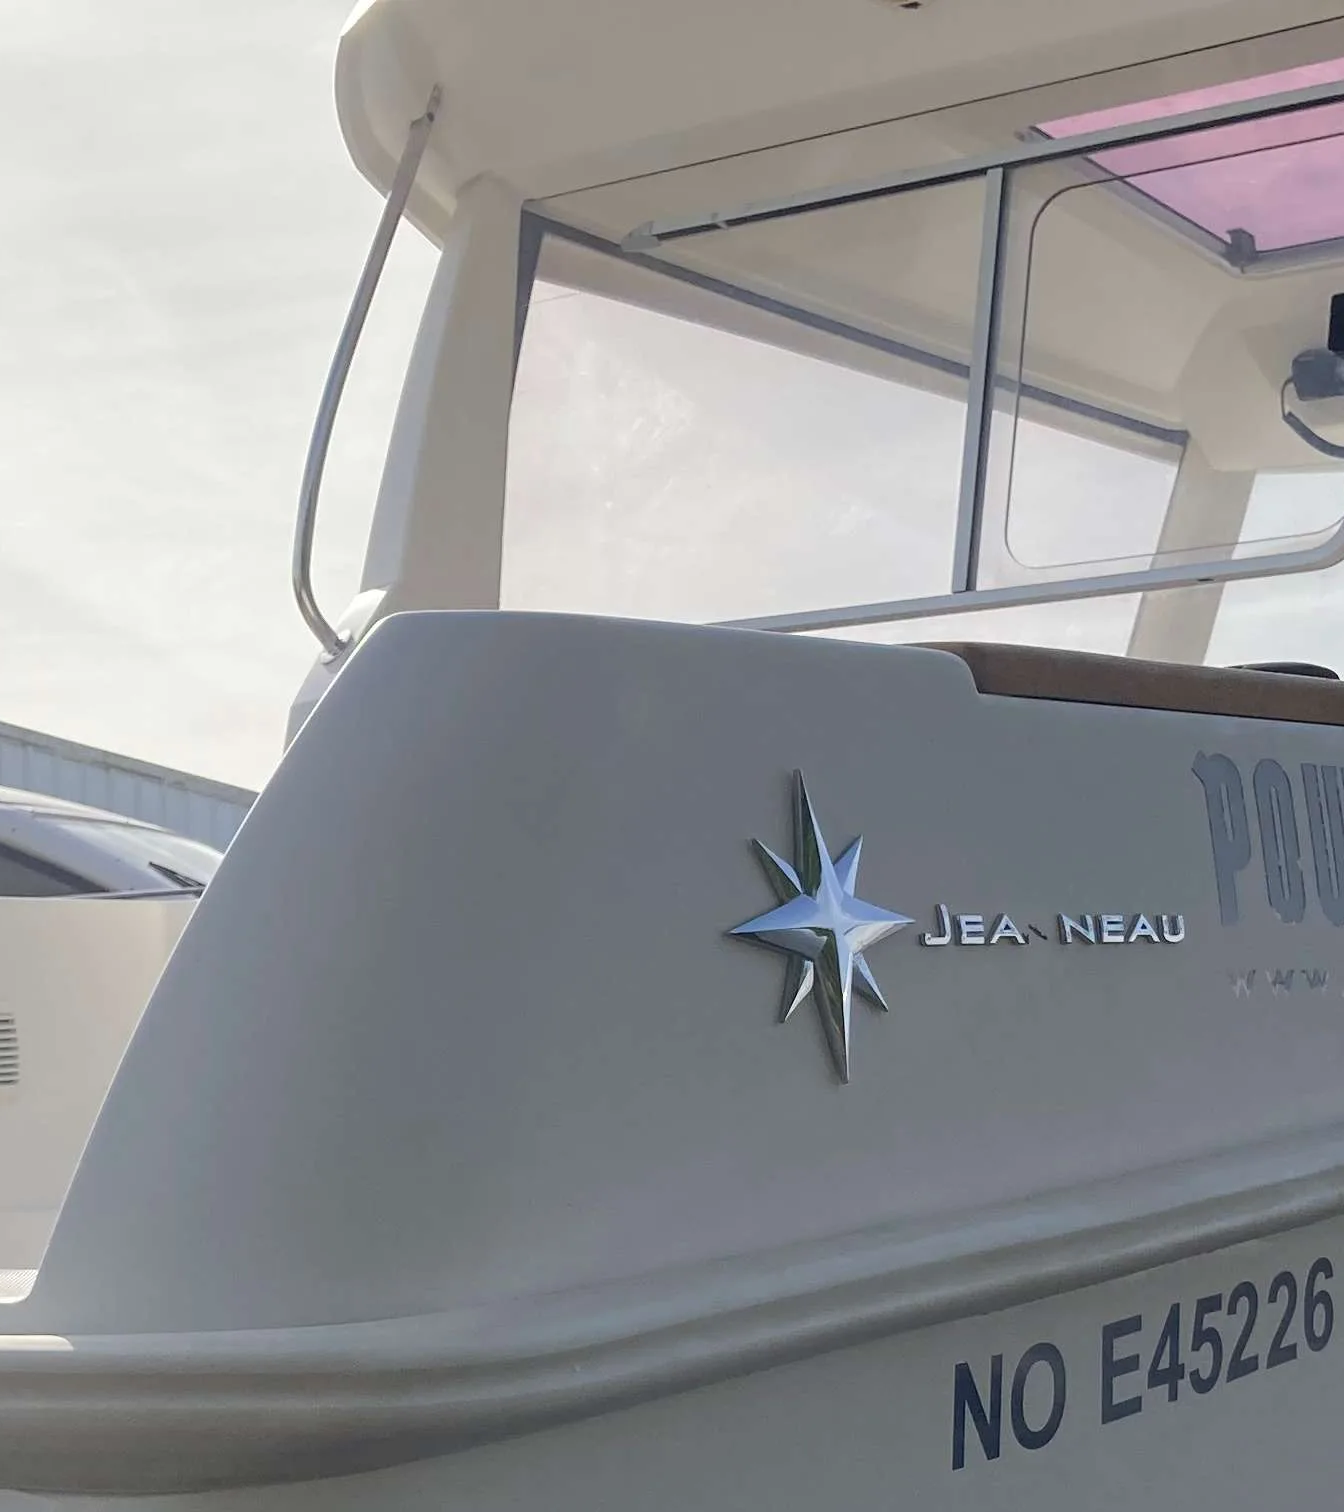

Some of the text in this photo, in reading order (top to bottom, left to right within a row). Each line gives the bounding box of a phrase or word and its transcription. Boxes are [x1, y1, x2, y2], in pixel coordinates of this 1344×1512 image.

[919, 903, 1186, 947] JEANEAU
[952, 1257, 1334, 1470] NO E45226
